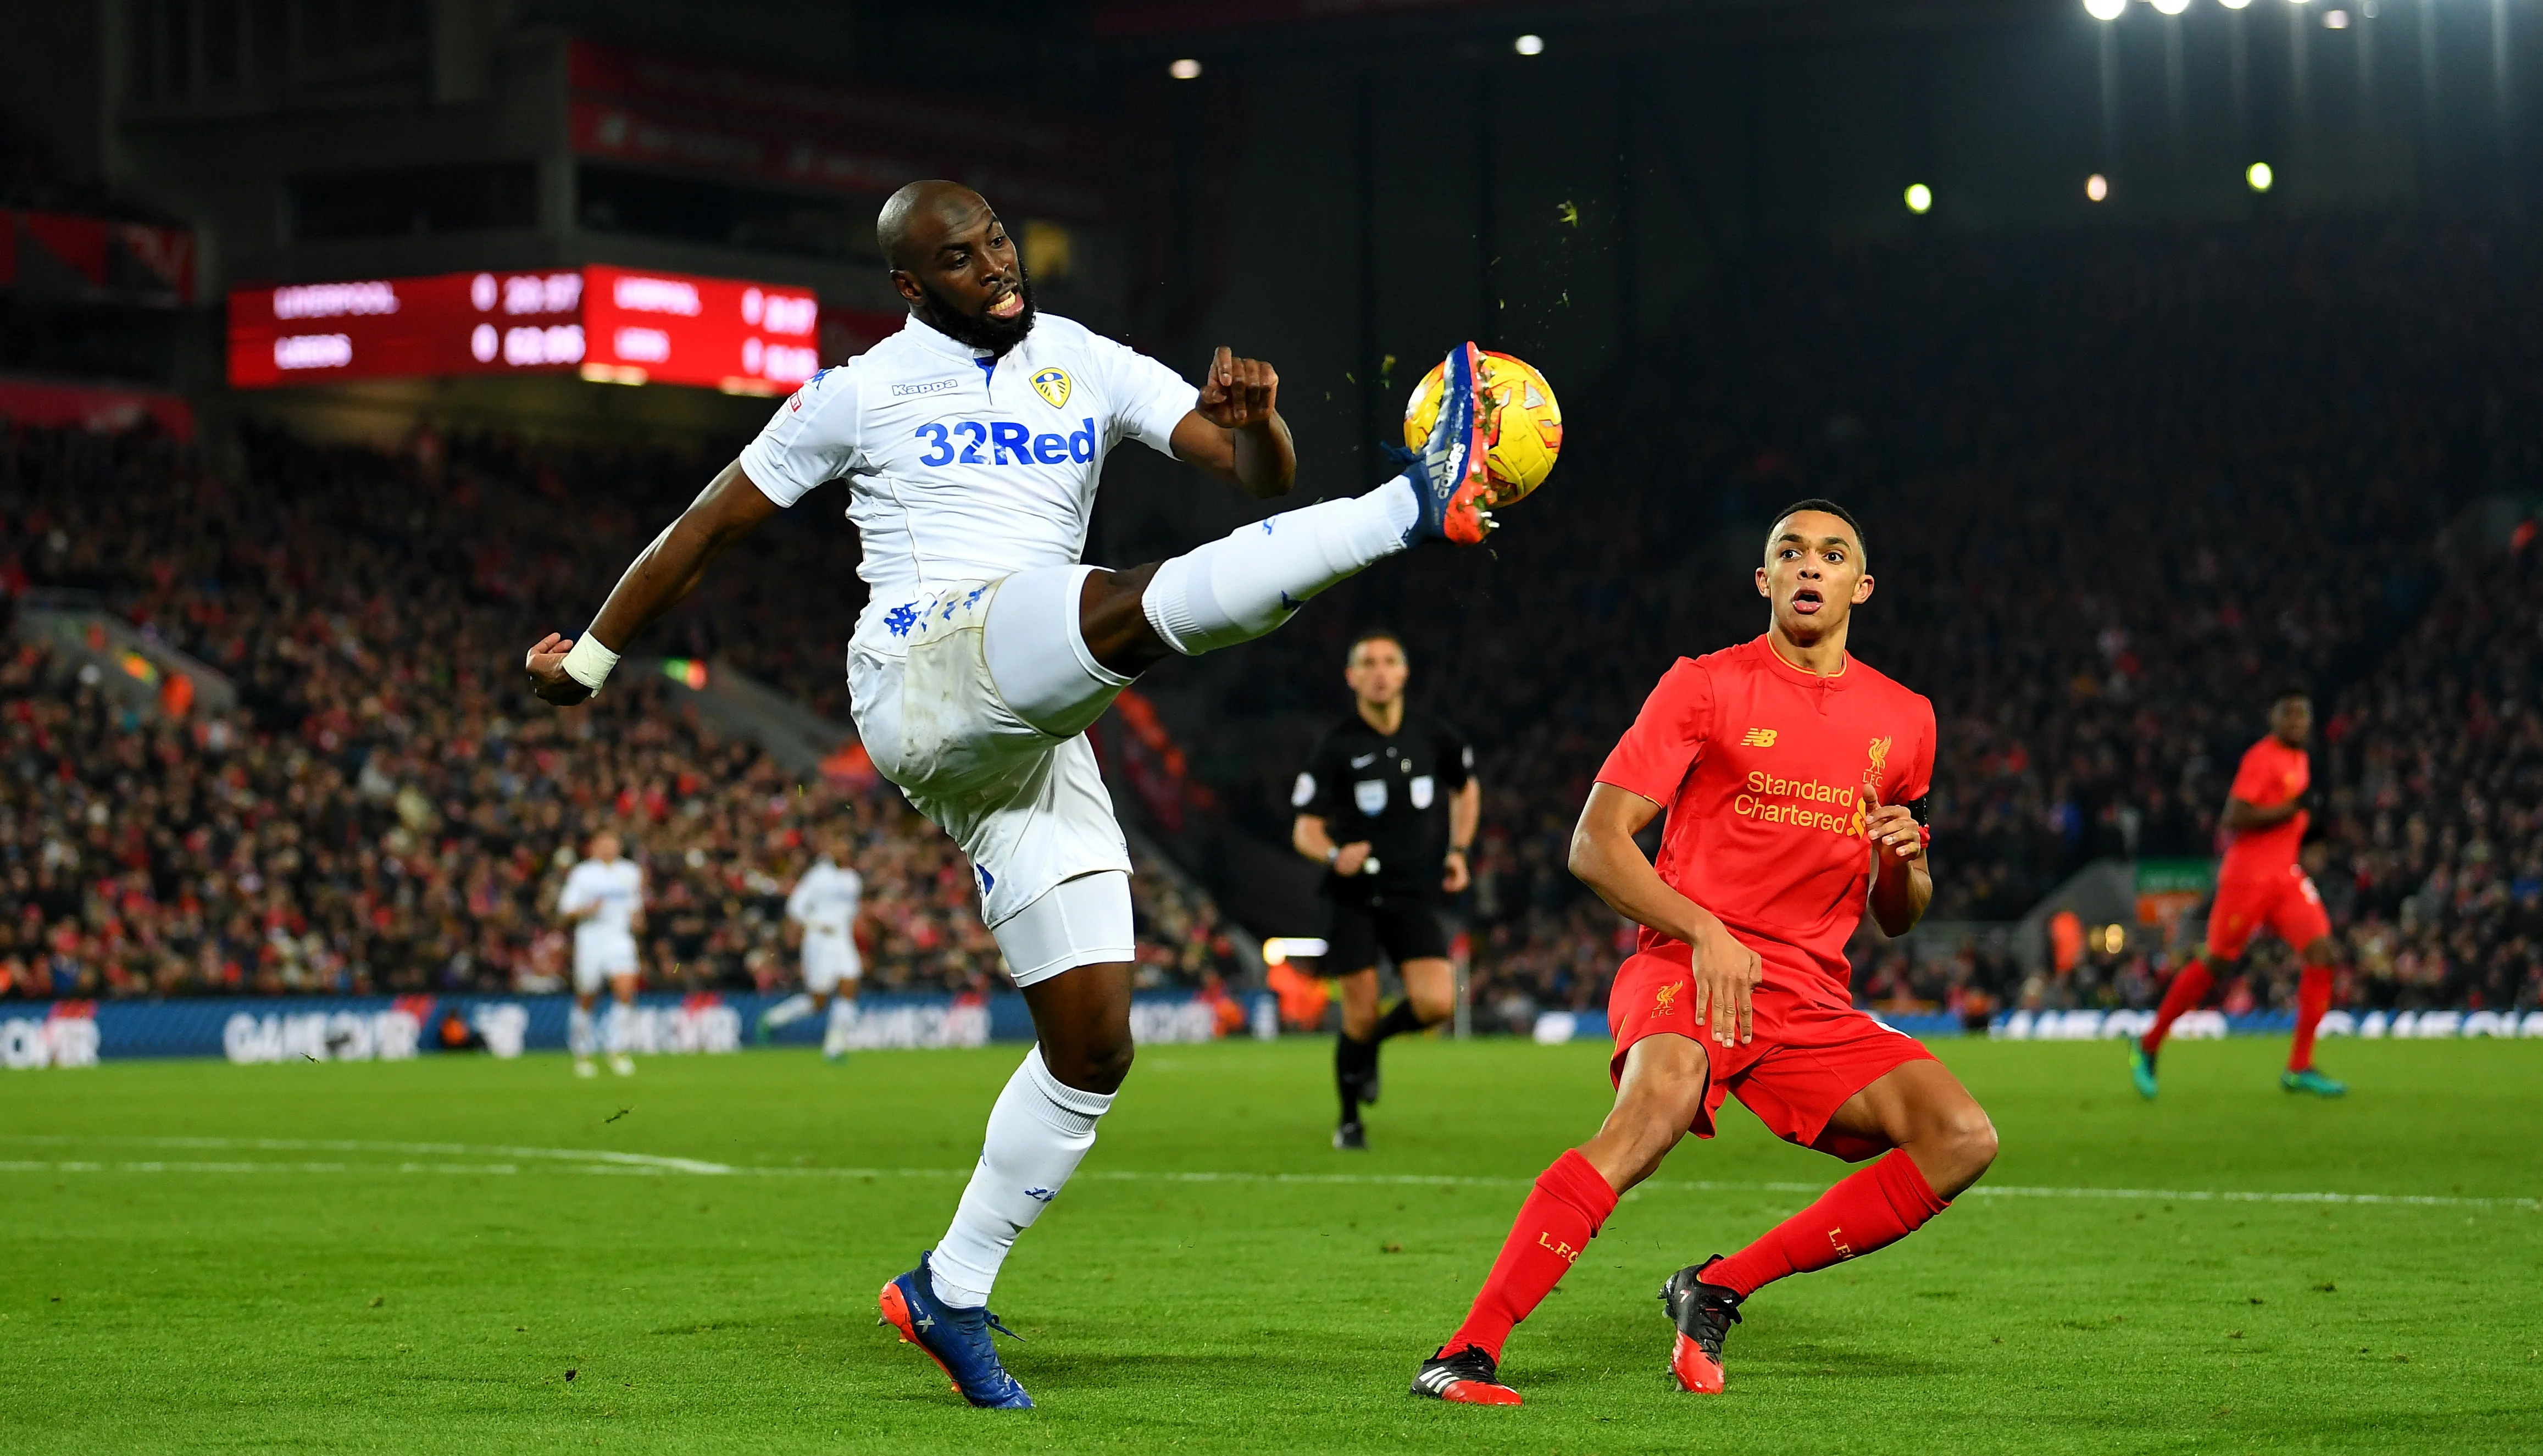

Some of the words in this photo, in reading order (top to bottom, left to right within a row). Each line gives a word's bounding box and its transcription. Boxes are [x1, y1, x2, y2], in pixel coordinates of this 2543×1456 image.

[892, 379, 958, 396] Kappa
[914, 417, 1095, 466] 32Red
[1747, 771, 1854, 807] Standard
[1734, 794, 1848, 834] Chartered
